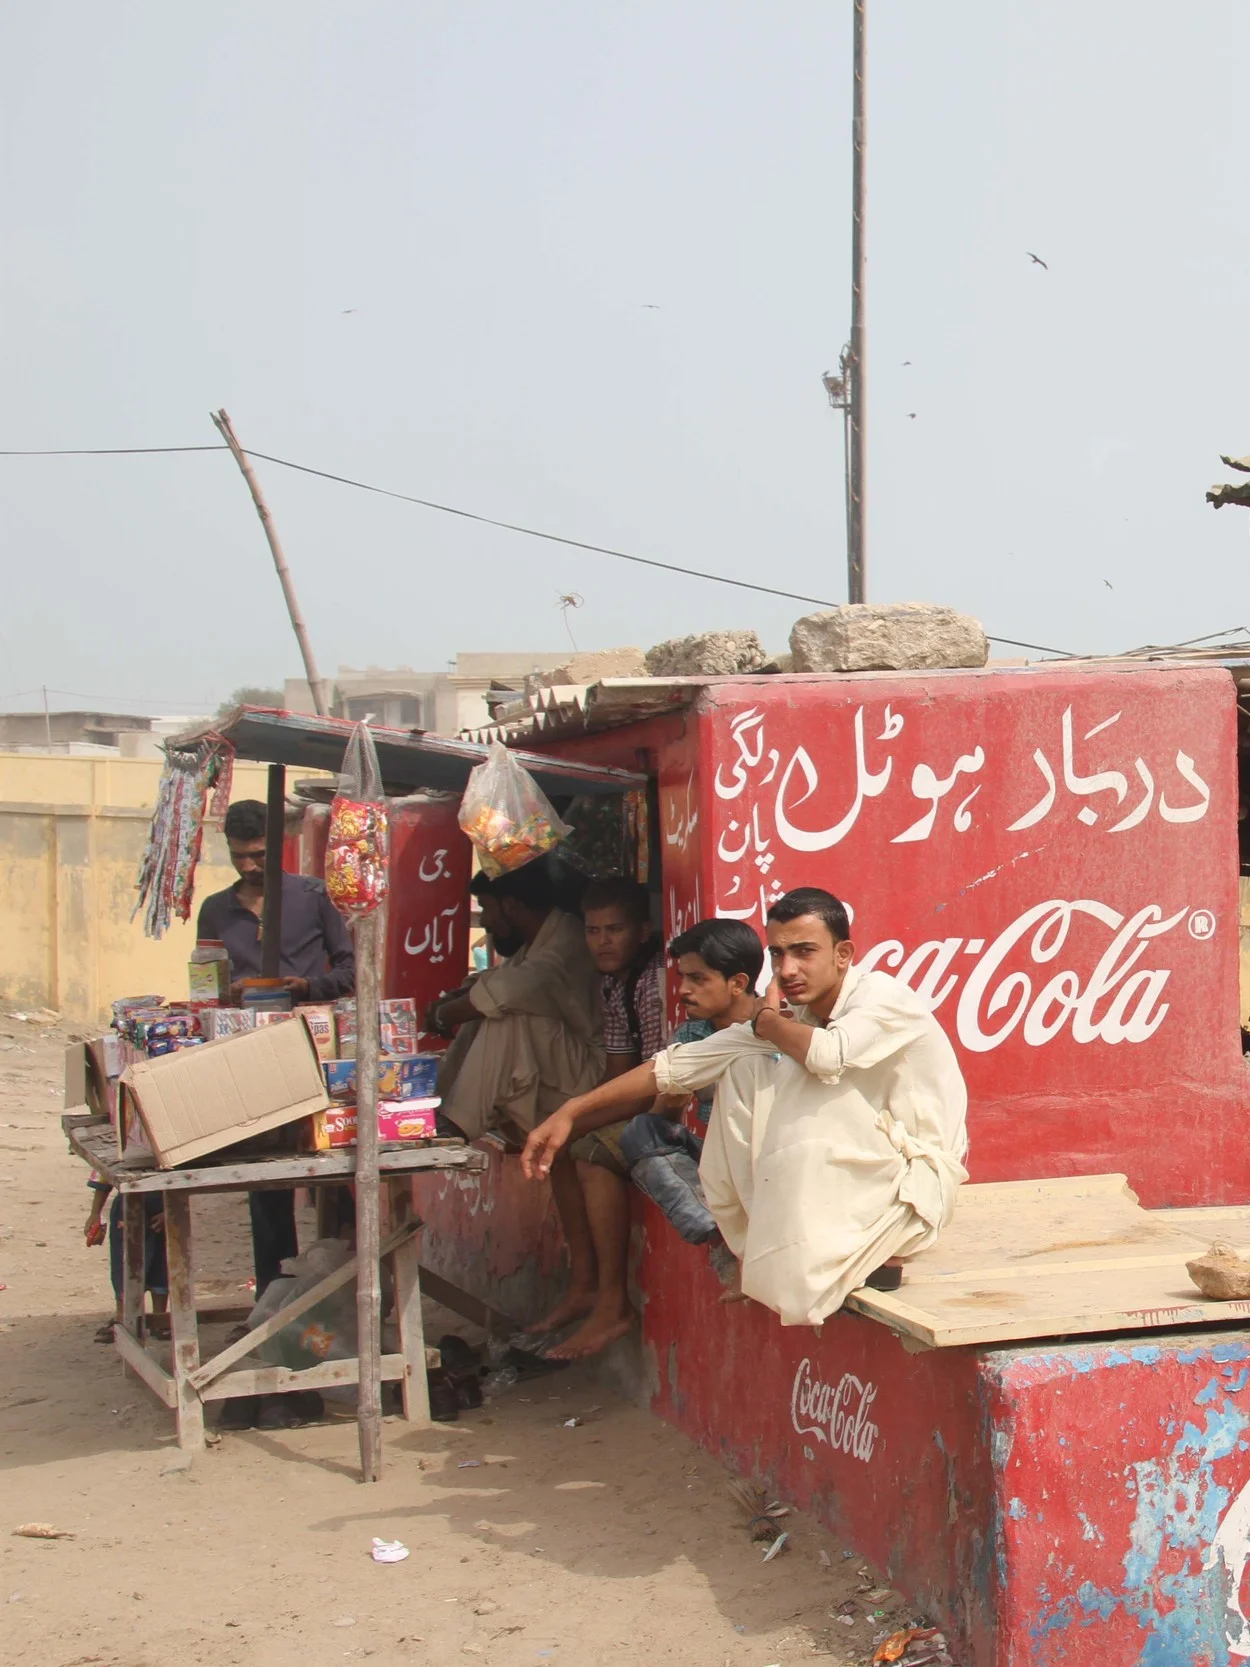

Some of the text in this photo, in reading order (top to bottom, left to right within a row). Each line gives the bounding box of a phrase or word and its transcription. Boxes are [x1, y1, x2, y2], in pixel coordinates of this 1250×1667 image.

[775, 703, 986, 852] ہوٹل
[755, 899, 1190, 1053] ca-Cola
[791, 1358, 879, 1463] Coca-Cola
